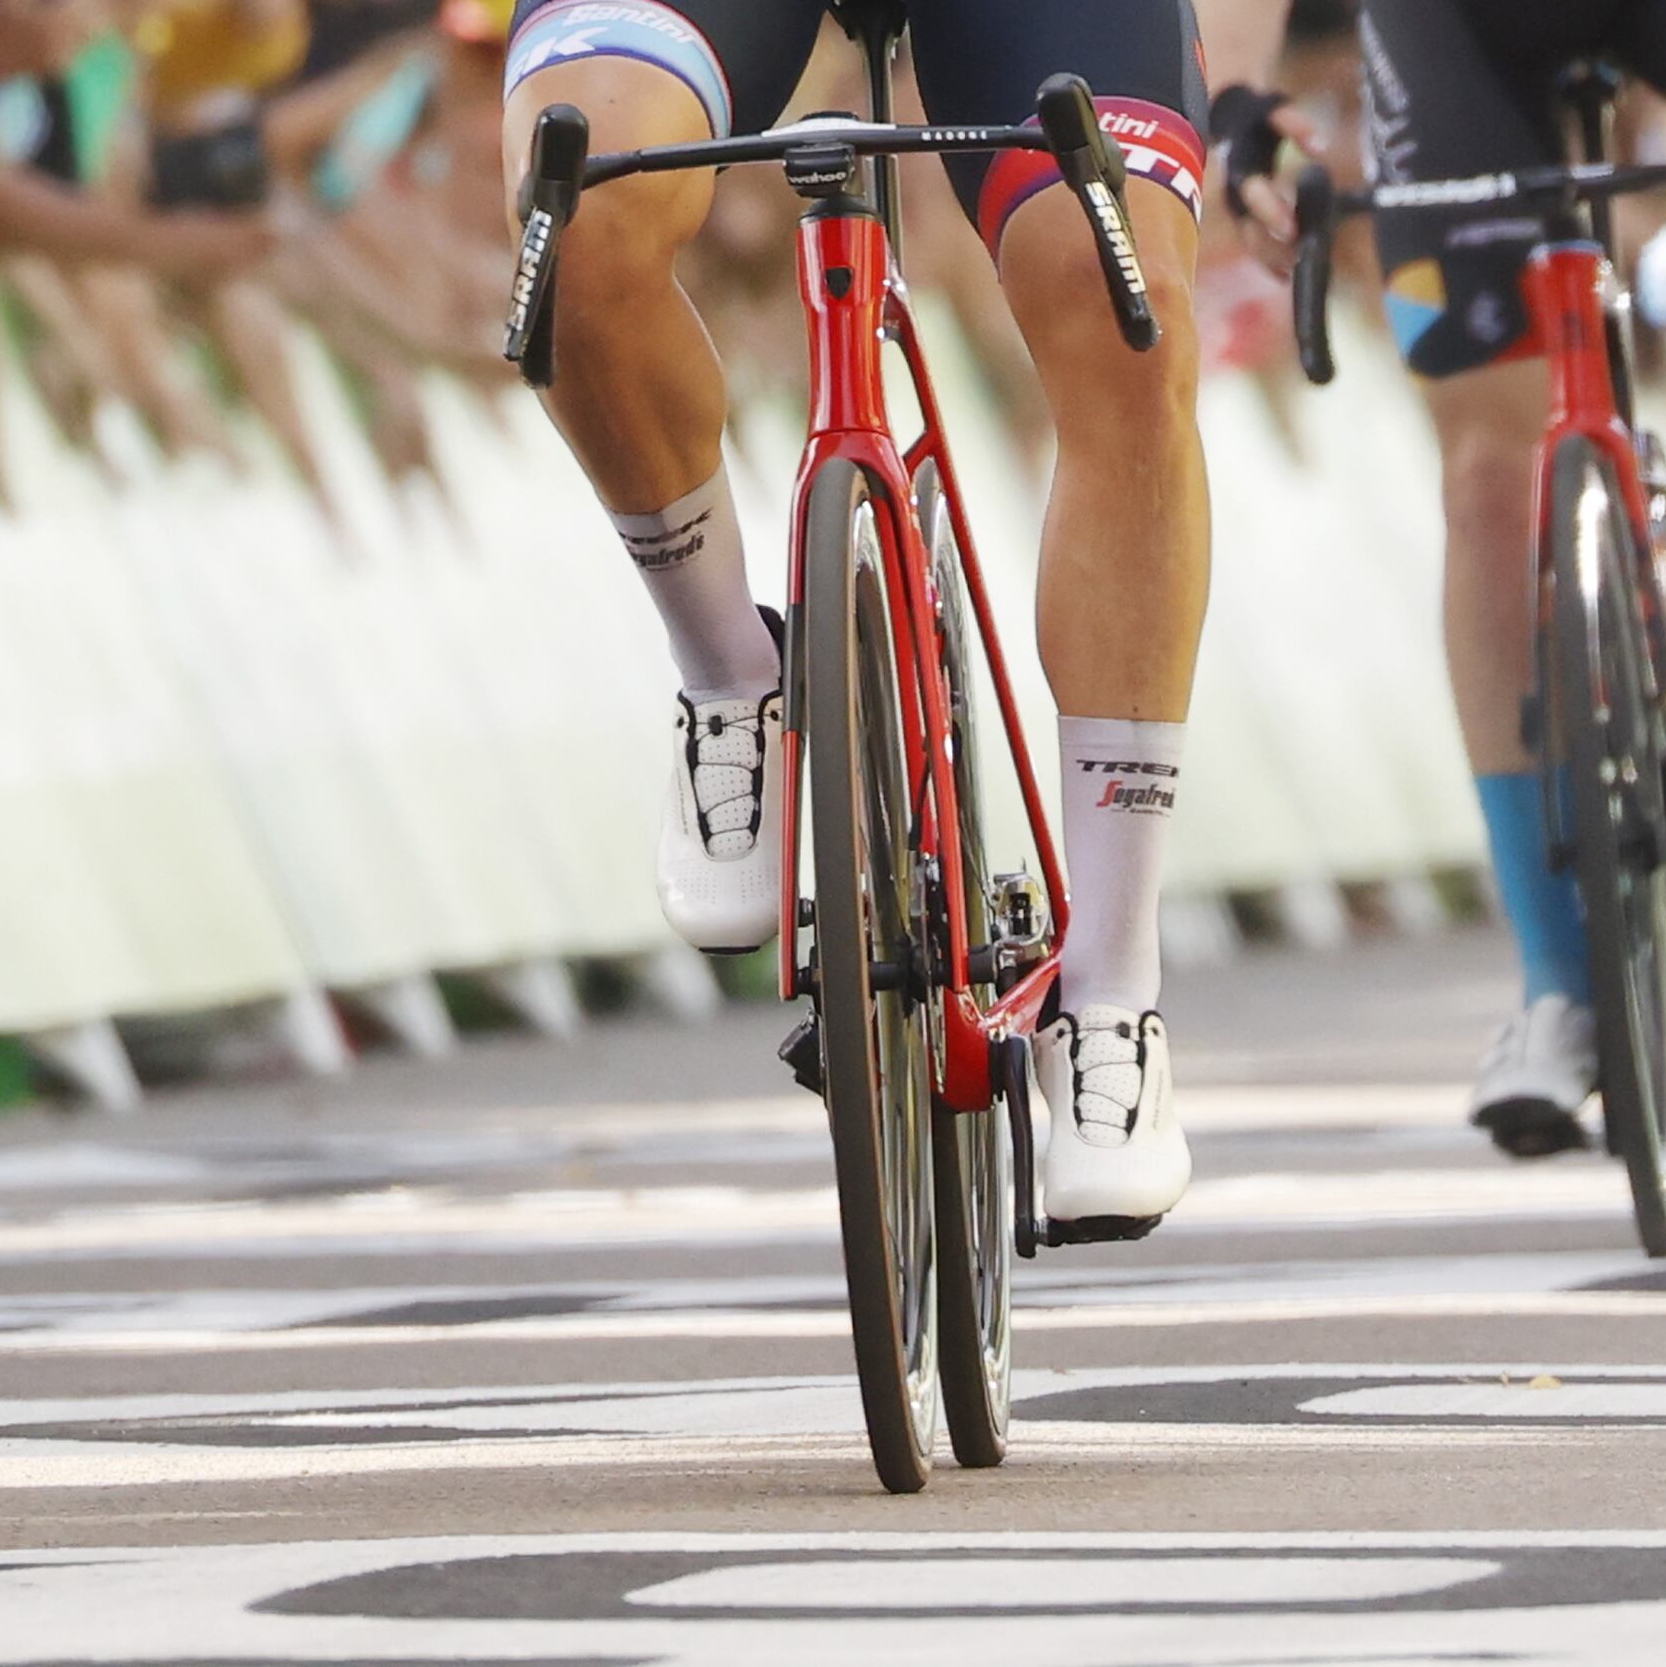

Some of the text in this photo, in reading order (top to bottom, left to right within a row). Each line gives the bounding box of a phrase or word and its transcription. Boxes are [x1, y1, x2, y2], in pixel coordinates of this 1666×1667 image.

[788, 172, 847, 185] wahoo
[506, 210, 553, 331] SRAM
[1085, 181, 1147, 295] SRAM
